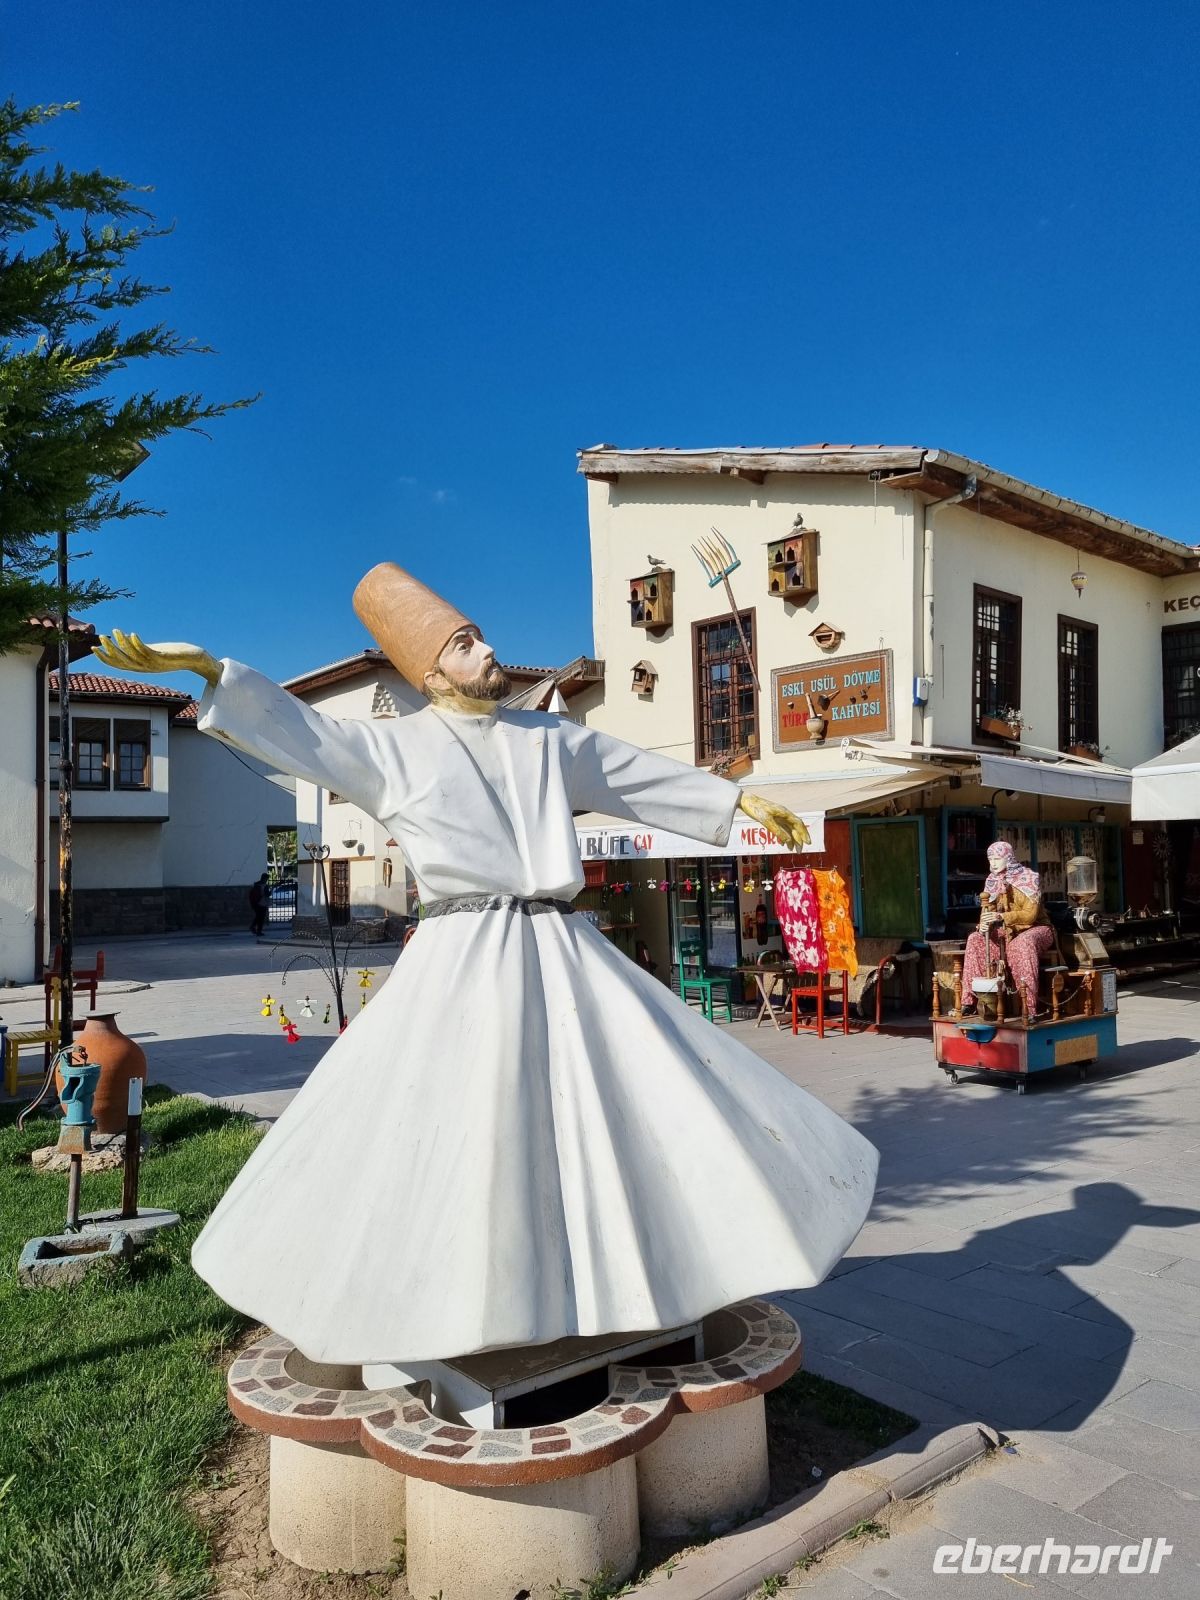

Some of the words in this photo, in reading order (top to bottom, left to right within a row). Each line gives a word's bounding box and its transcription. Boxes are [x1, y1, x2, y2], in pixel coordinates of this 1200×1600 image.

[782, 680, 804, 697] ESKİ
[810, 675, 837, 692] USÜL
[844, 669, 881, 688] DÖVME
[831, 699, 881, 721] KAHVESİ
[586, 831, 630, 856] BÜFE
[633, 833, 653, 855] ÇAY
